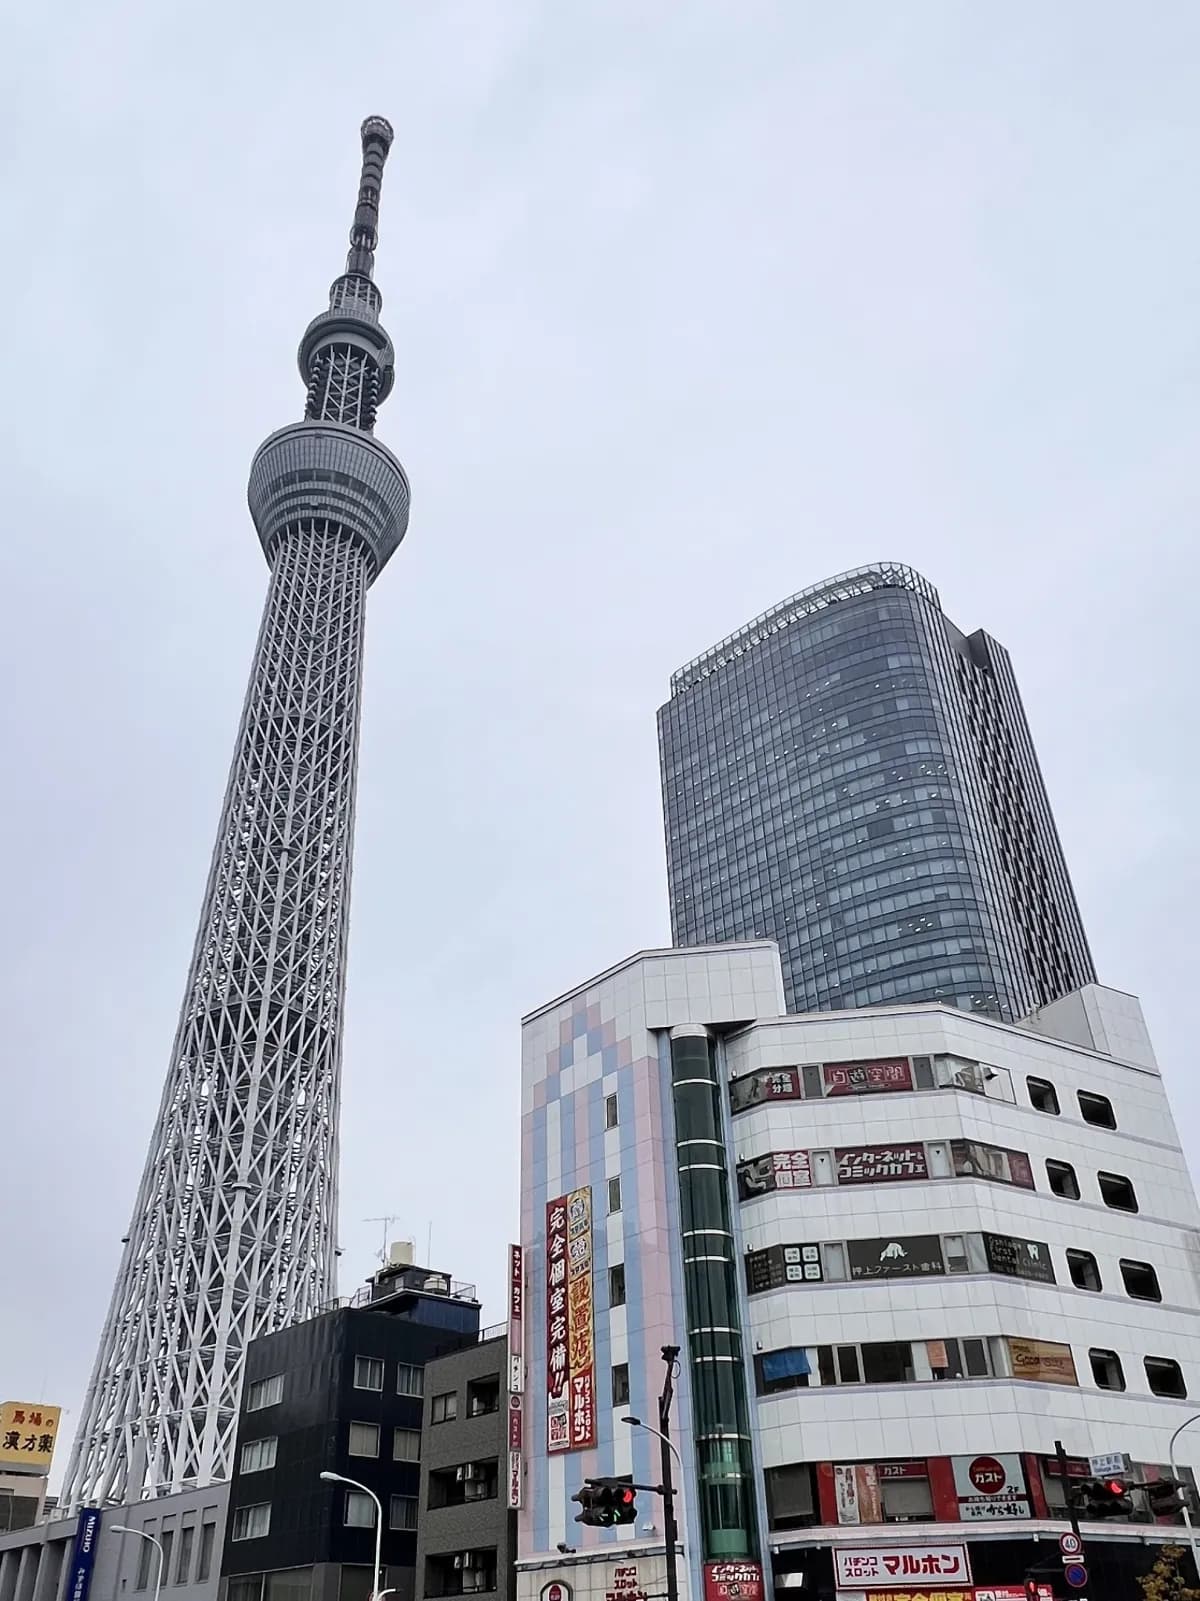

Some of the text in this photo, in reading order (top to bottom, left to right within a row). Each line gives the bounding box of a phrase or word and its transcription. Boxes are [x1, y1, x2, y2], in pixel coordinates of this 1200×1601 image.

[773, 1152, 809, 1170] 完全
[839, 1161, 925, 1178] コミックカフェ
[573, 1377, 585, 1442] マルホン
[13, 1410, 54, 1427] 馬場の
[2, 1431, 53, 1452] 漢方薬
[884, 1466, 907, 1476] ガスト
[975, 1472, 1002, 1483] ガスト
[1006, 1485, 1019, 1494] 2F
[83, 1515, 96, 1553] MIZUHO
[1065, 1538, 1076, 1549] 40
[844, 1556, 878, 1567] パチンコ
[883, 1555, 960, 1575] マルホン
[845, 1567, 879, 1578] スロット
